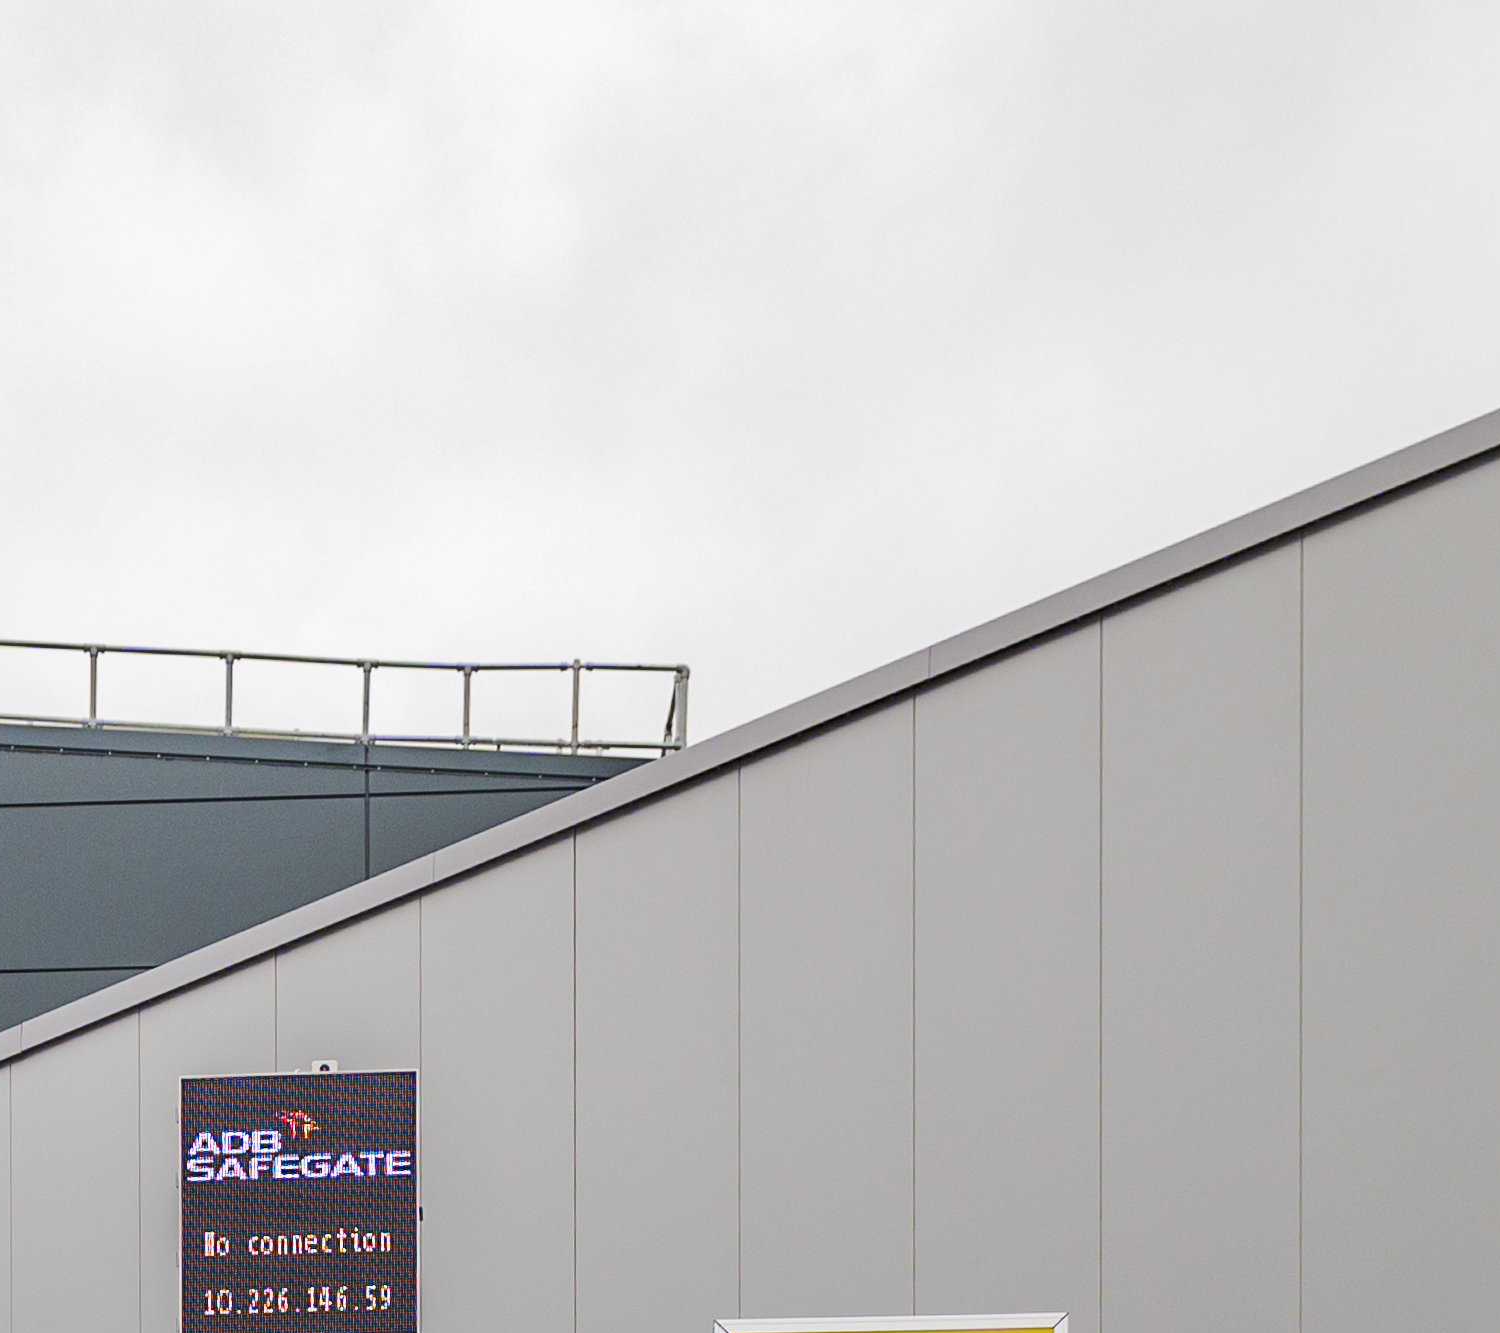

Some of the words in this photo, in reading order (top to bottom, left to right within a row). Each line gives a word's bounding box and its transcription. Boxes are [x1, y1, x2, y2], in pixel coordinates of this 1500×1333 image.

[188, 1128, 282, 1155] ADB
[186, 1150, 412, 1182] SAFEGATE
[204, 1231, 230, 1257] No
[248, 1227, 391, 1256] connection
[204, 1285, 392, 1316] 10.226.146.59
